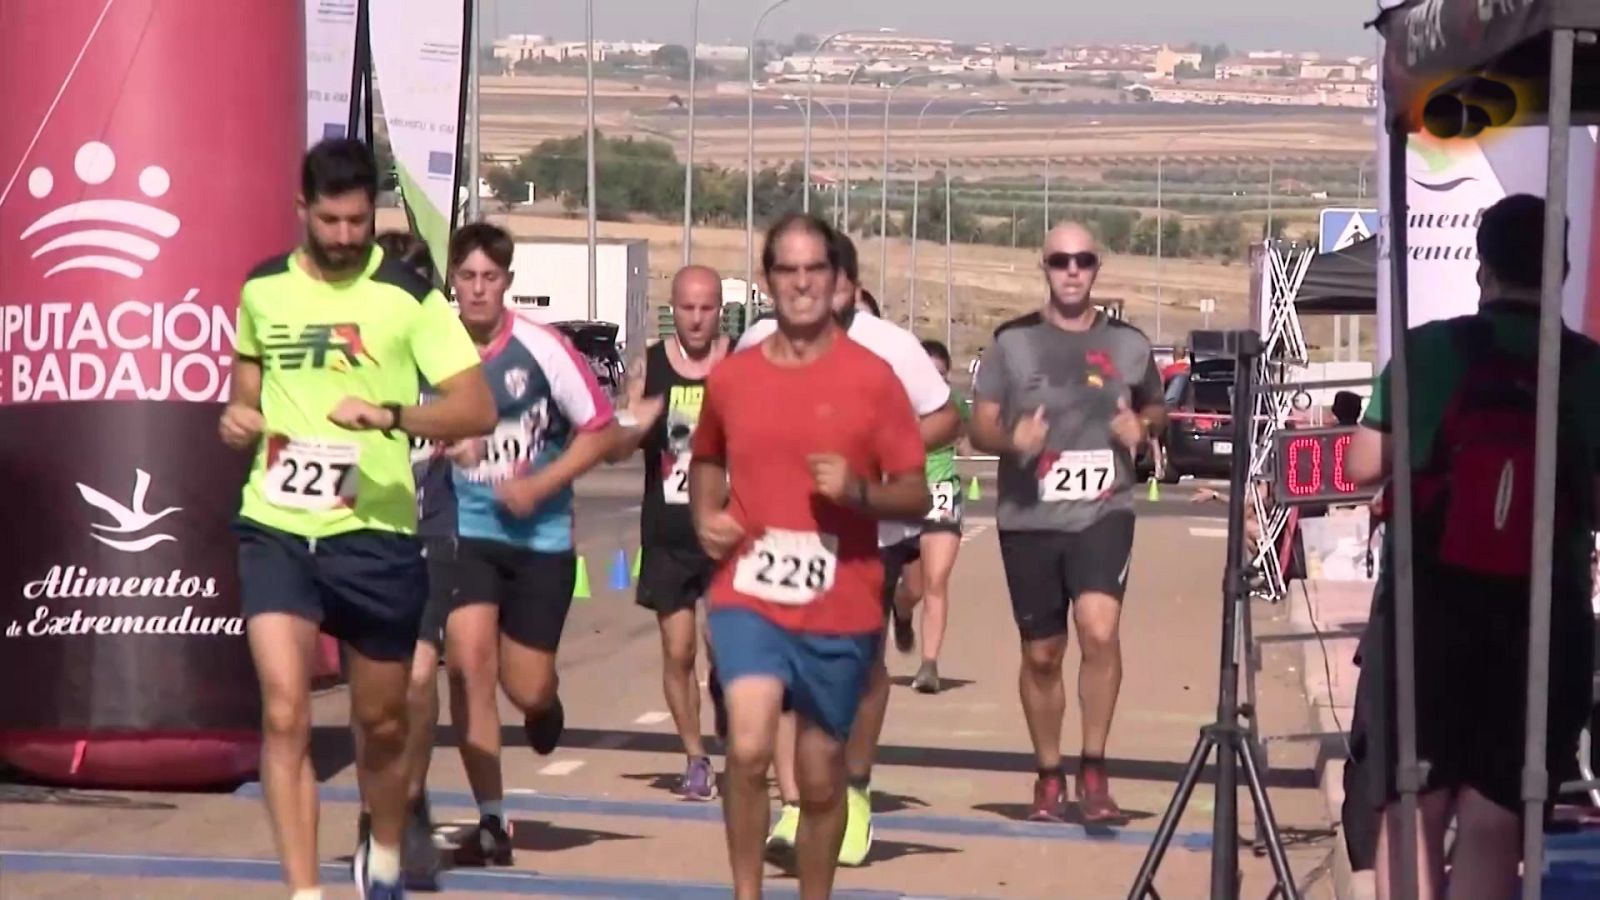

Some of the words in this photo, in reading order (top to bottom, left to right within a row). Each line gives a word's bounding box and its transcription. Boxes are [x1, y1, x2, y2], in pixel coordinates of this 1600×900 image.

[281, 457, 353, 497] 227
[1055, 467, 1109, 491] 217
[22, 564, 220, 599] Alimentos
[755, 550, 827, 592] 228
[5, 620, 22, 638] de
[27, 605, 245, 637] Extremadura
